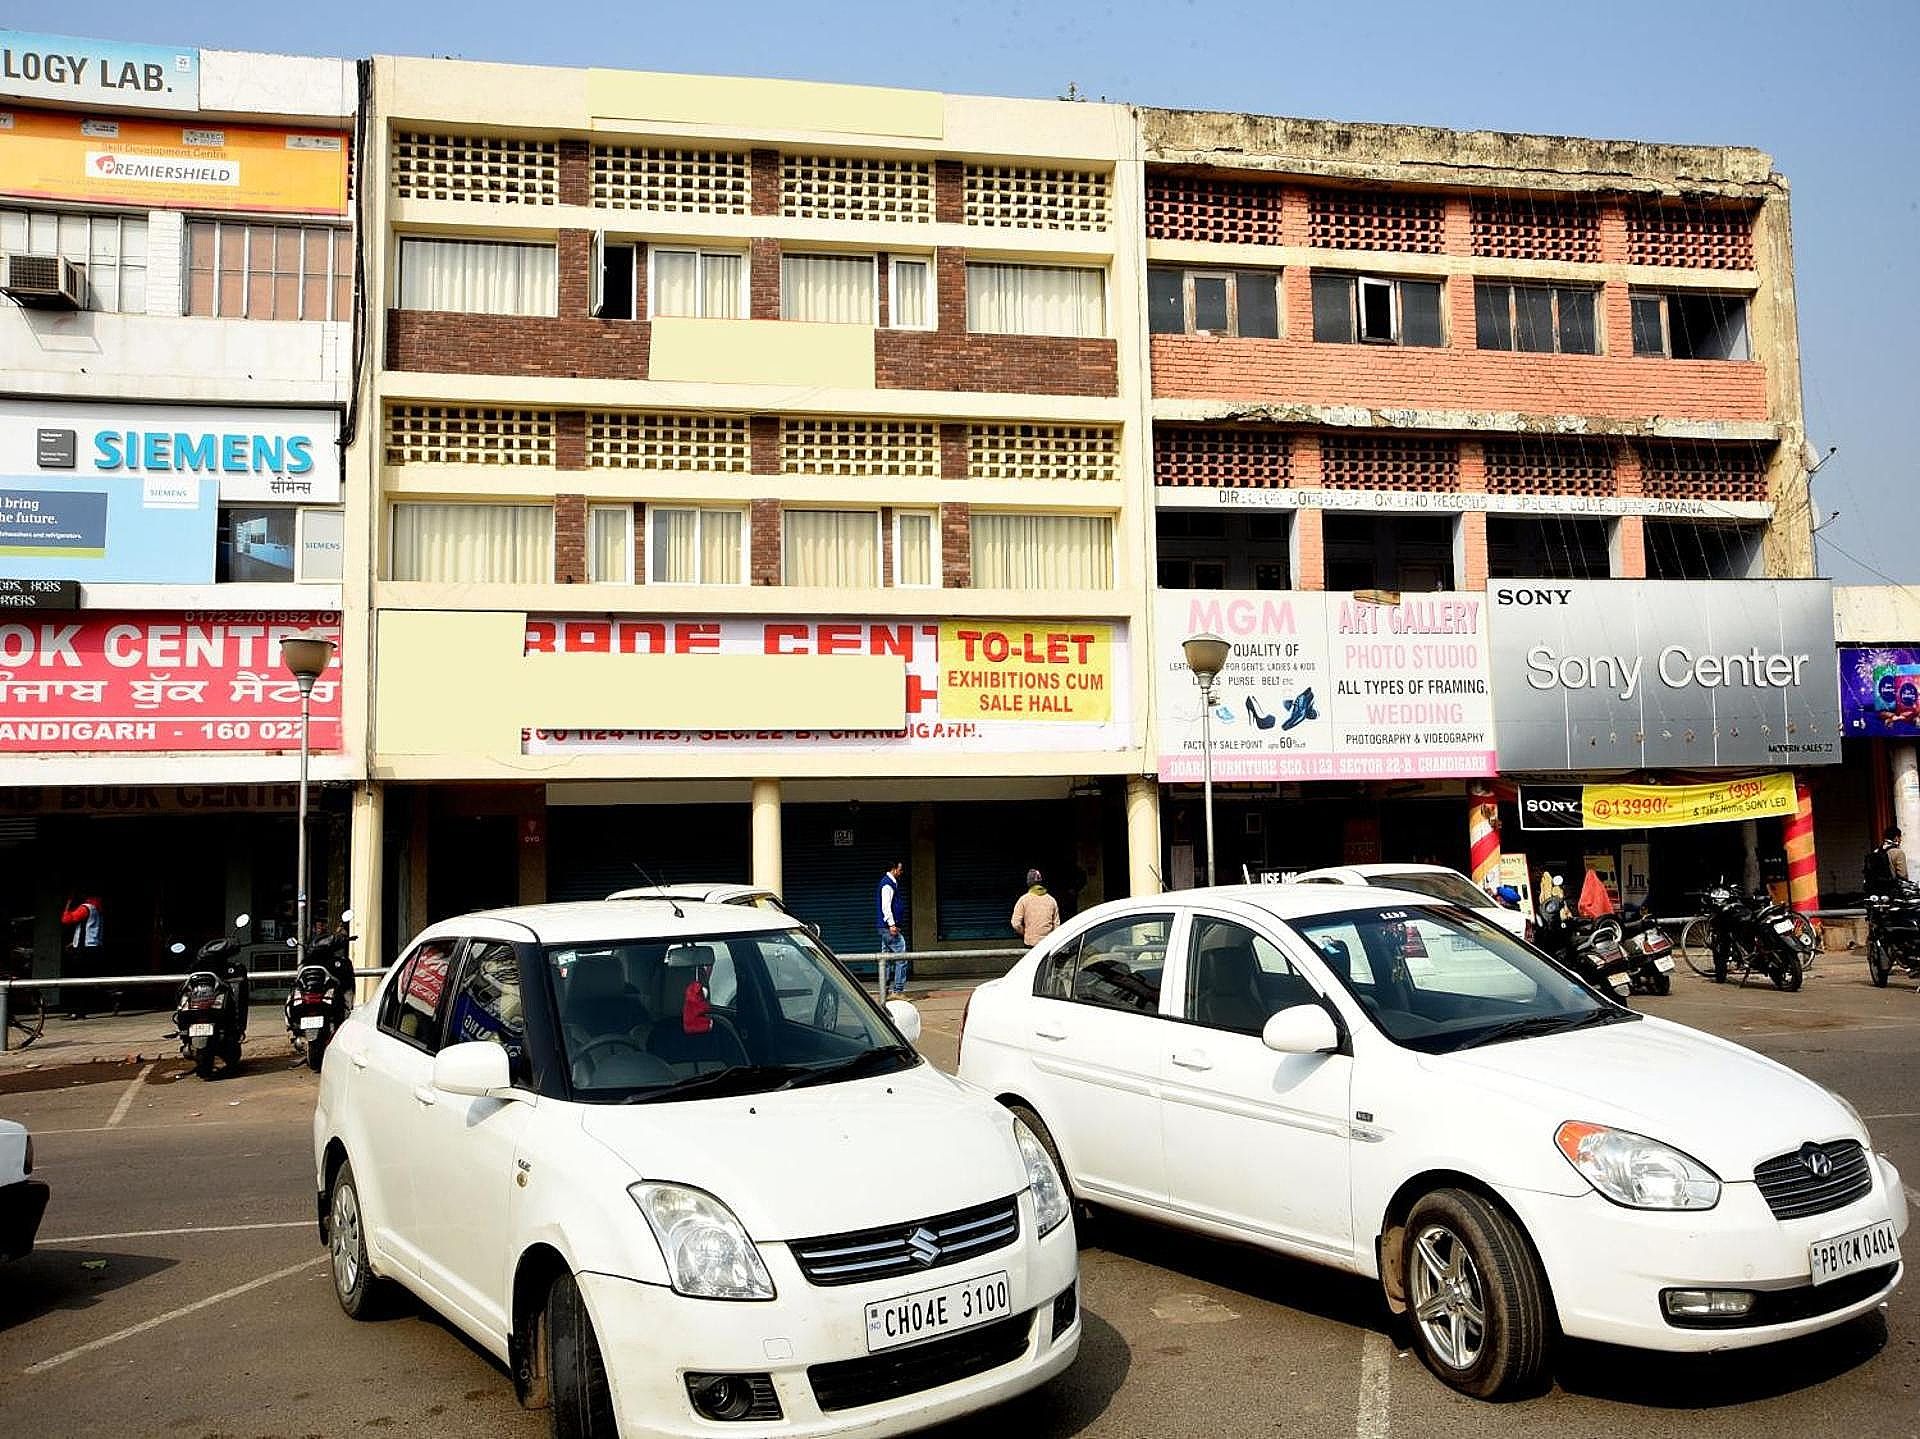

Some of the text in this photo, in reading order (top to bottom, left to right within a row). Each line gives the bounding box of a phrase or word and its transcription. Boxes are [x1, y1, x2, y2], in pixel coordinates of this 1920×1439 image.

[3, 49, 173, 93] LOGY LAB.
[94, 430, 314, 474] SIEMENS
[269, 477, 312, 495] सीमेन्स
[5, 497, 39, 512] bring
[16, 512, 58, 525] future.
[1497, 588, 1572, 605] SONY
[1188, 598, 1296, 636] MGM
[1338, 600, 1480, 635] ART GALLERY
[956, 630, 1096, 665] TO-LET
[1233, 643, 1300, 658] QUALITY OF
[1344, 643, 1478, 670] PHOTO STUDIO
[947, 670, 1104, 691] EXHIBITIONS CUM
[1526, 644, 1810, 701] Sony Center
[1337, 680, 1361, 695] ALL
[1364, 680, 1404, 695] TYPES
[1408, 680, 1424, 695] OF
[979, 693, 1074, 713] SALE HALL
[1366, 703, 1464, 725] WEDDING
[201, 722, 250, 740] 160
[1345, 732, 1485, 745] PHOTOGRAPHY & VIDEOGRAPHY
[1220, 740, 1238, 750] SALE
[1240, 740, 1263, 750] POINT
[1339, 759, 1381, 774] SECTOR
[1418, 756, 1486, 773] CHANDIGARH
[1526, 798, 1578, 813] SONY
[885, 1281, 1007, 1337] CH04E 3100
